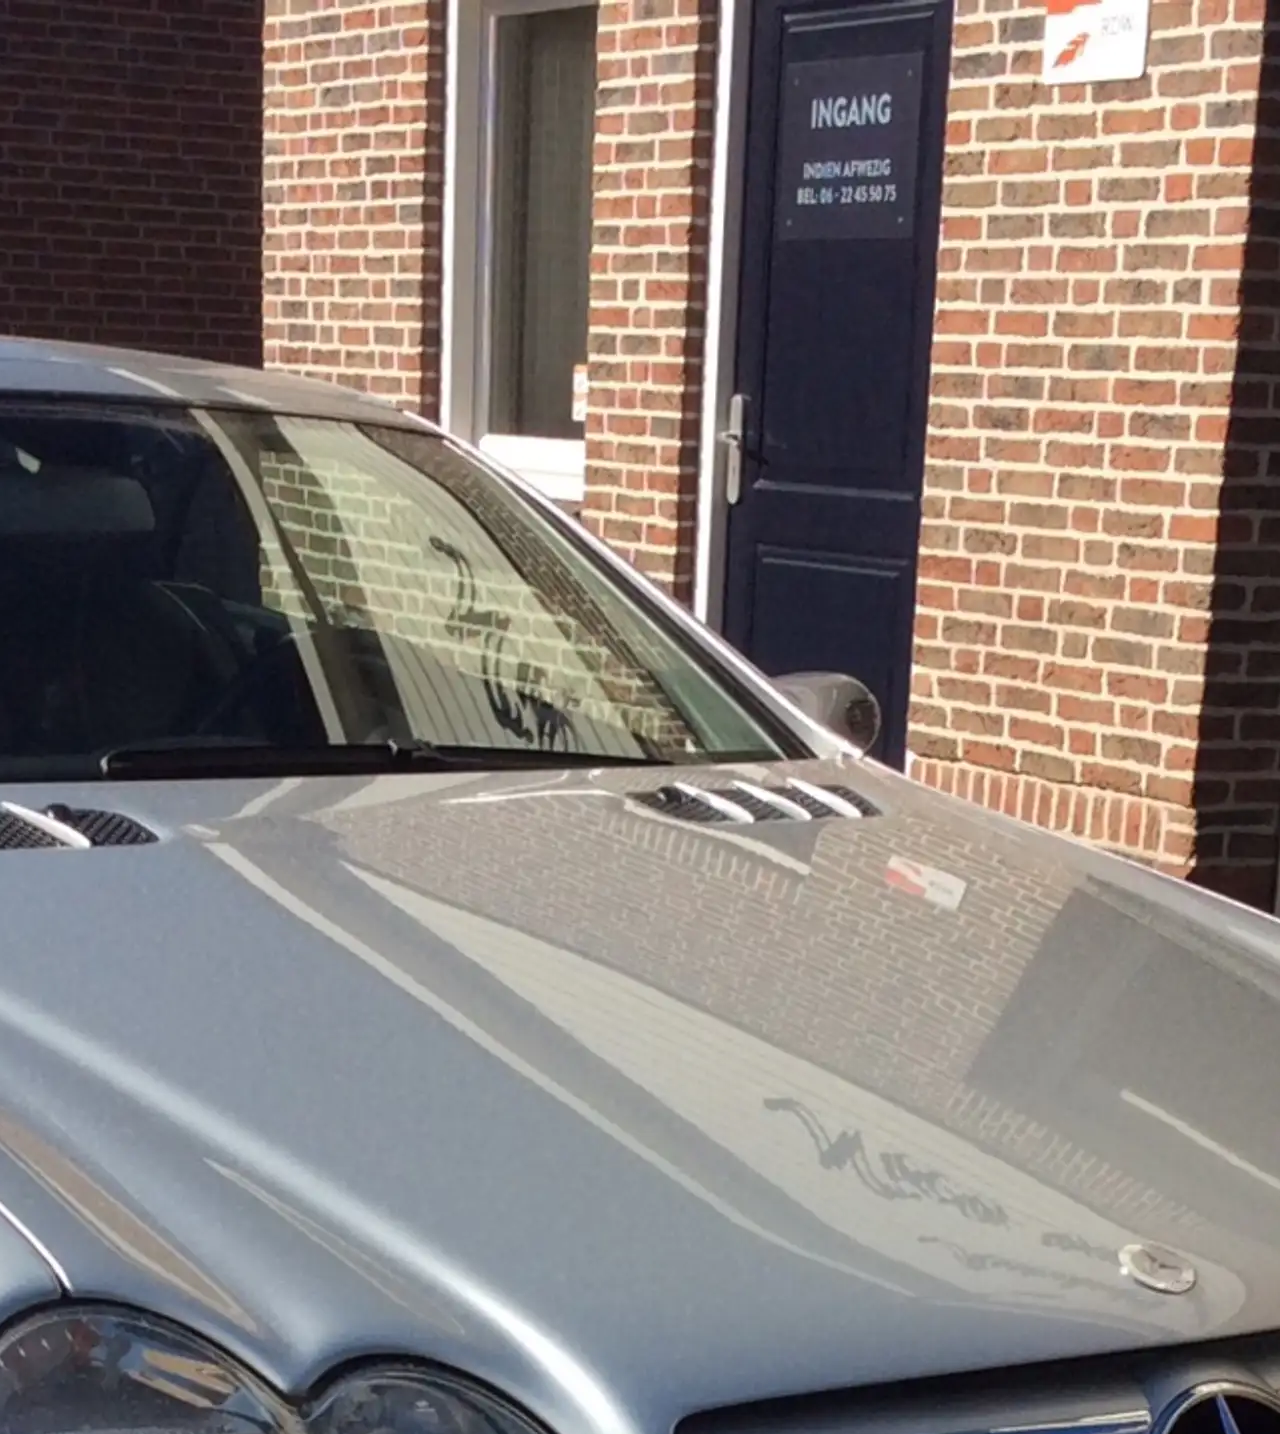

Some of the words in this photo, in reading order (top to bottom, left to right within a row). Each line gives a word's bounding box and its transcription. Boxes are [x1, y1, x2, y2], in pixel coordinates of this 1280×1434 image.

[811, 92, 892, 130] INGANG
[803, 161, 841, 180] INDIEN
[842, 158, 891, 178] AFWEZIG
